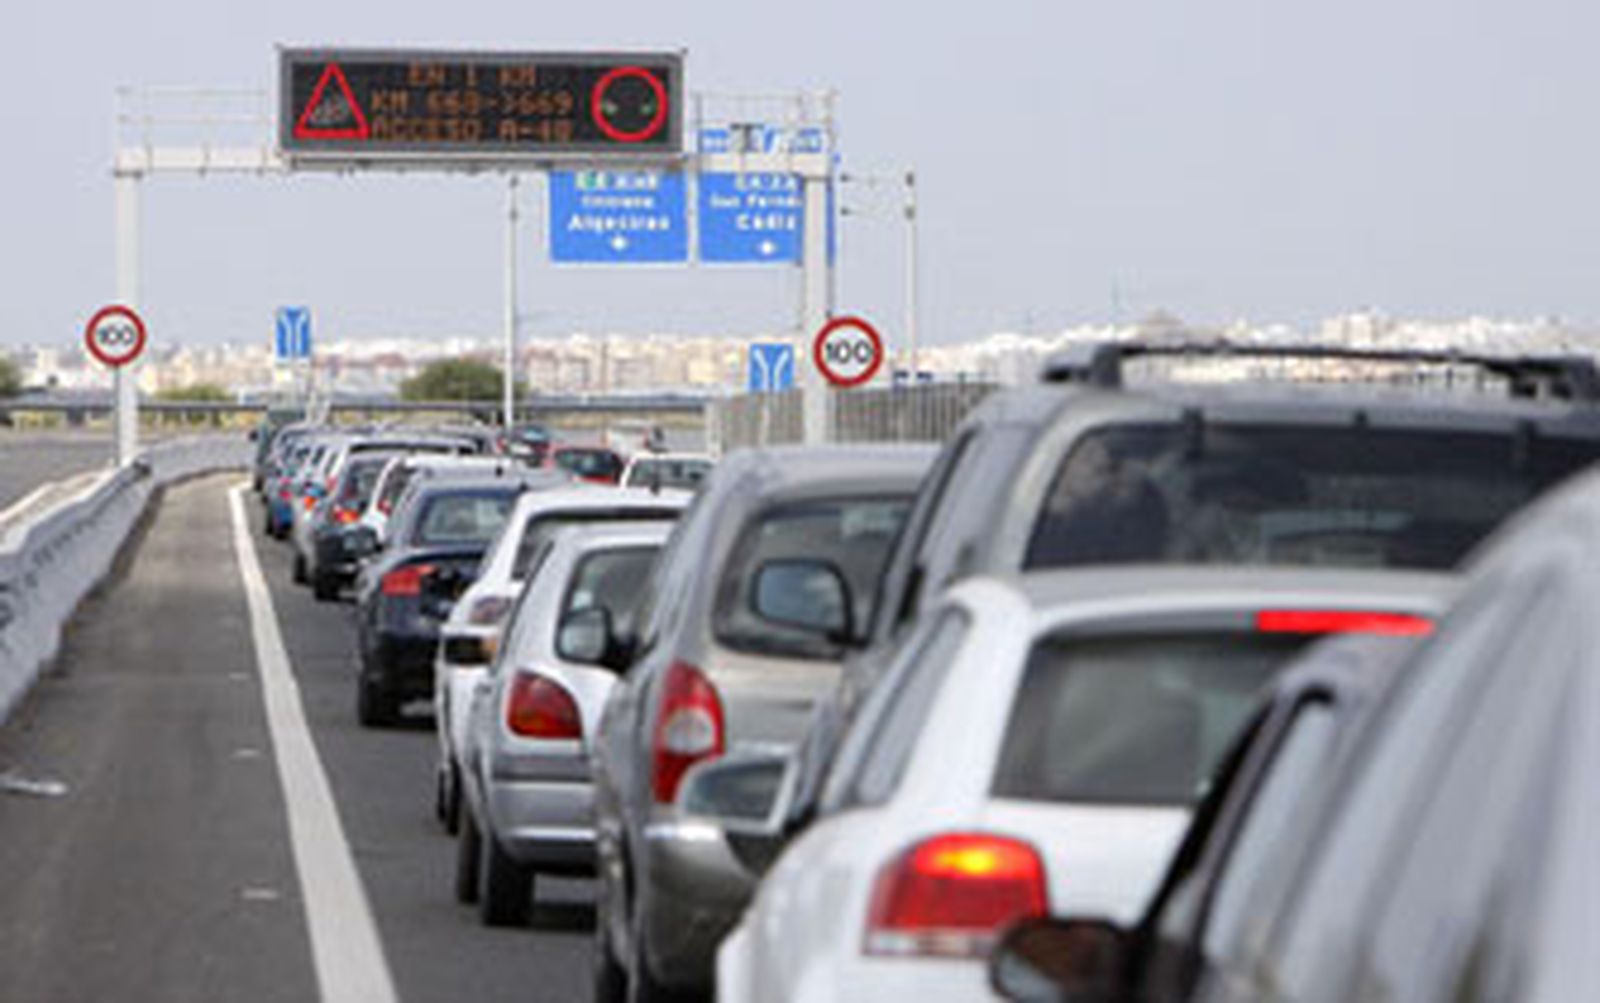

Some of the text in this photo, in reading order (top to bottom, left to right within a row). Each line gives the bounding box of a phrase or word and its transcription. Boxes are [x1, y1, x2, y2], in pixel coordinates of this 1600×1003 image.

[370, 90, 409, 114] KM
[567, 213, 671, 235] Algeciras
[97, 324, 137, 346] 100
[825, 339, 875, 364] 100
